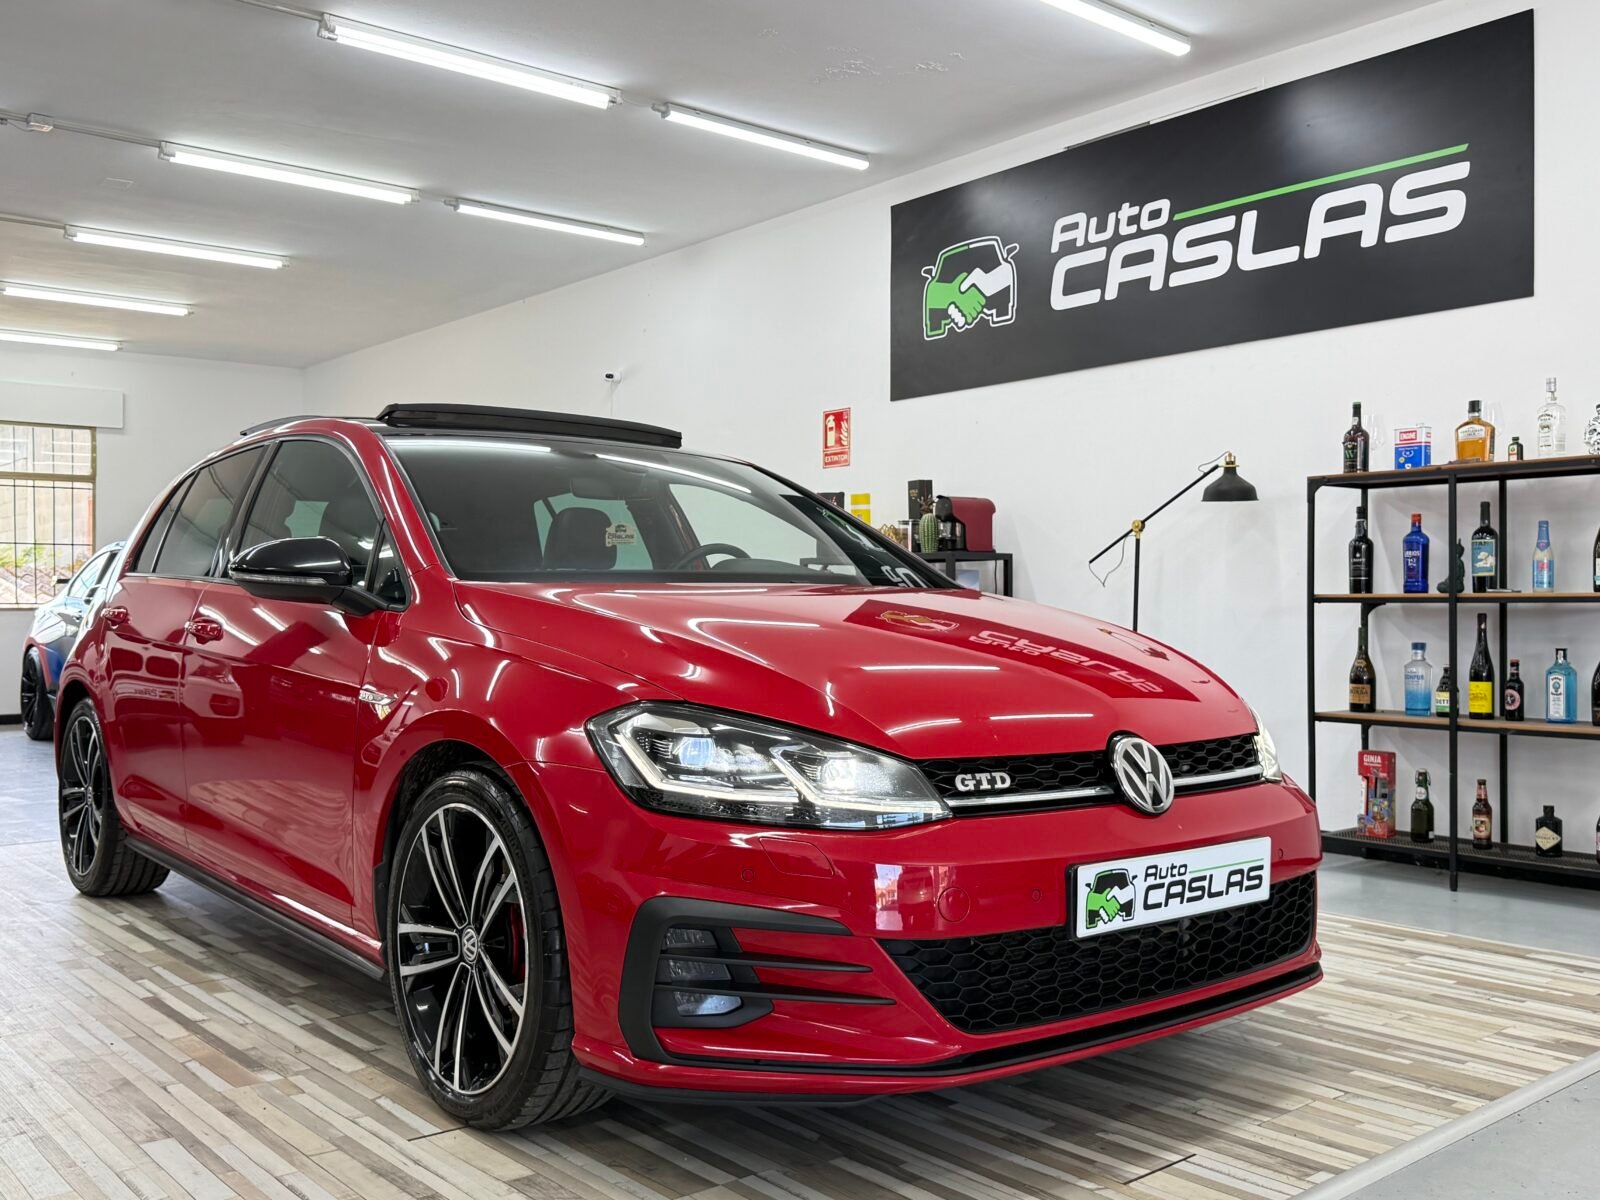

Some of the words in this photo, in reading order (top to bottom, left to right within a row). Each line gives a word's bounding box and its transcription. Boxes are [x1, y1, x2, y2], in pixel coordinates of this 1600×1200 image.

[1050, 198, 1171, 254] Auto
[1050, 161, 1471, 311] CASLAS
[824, 454, 848, 463] EXTINTOR
[1363, 753, 1382, 763] GINJA
[954, 771, 1012, 792] GTD
[1143, 862, 1188, 883] Auto
[1142, 864, 1265, 911] CASLAS
